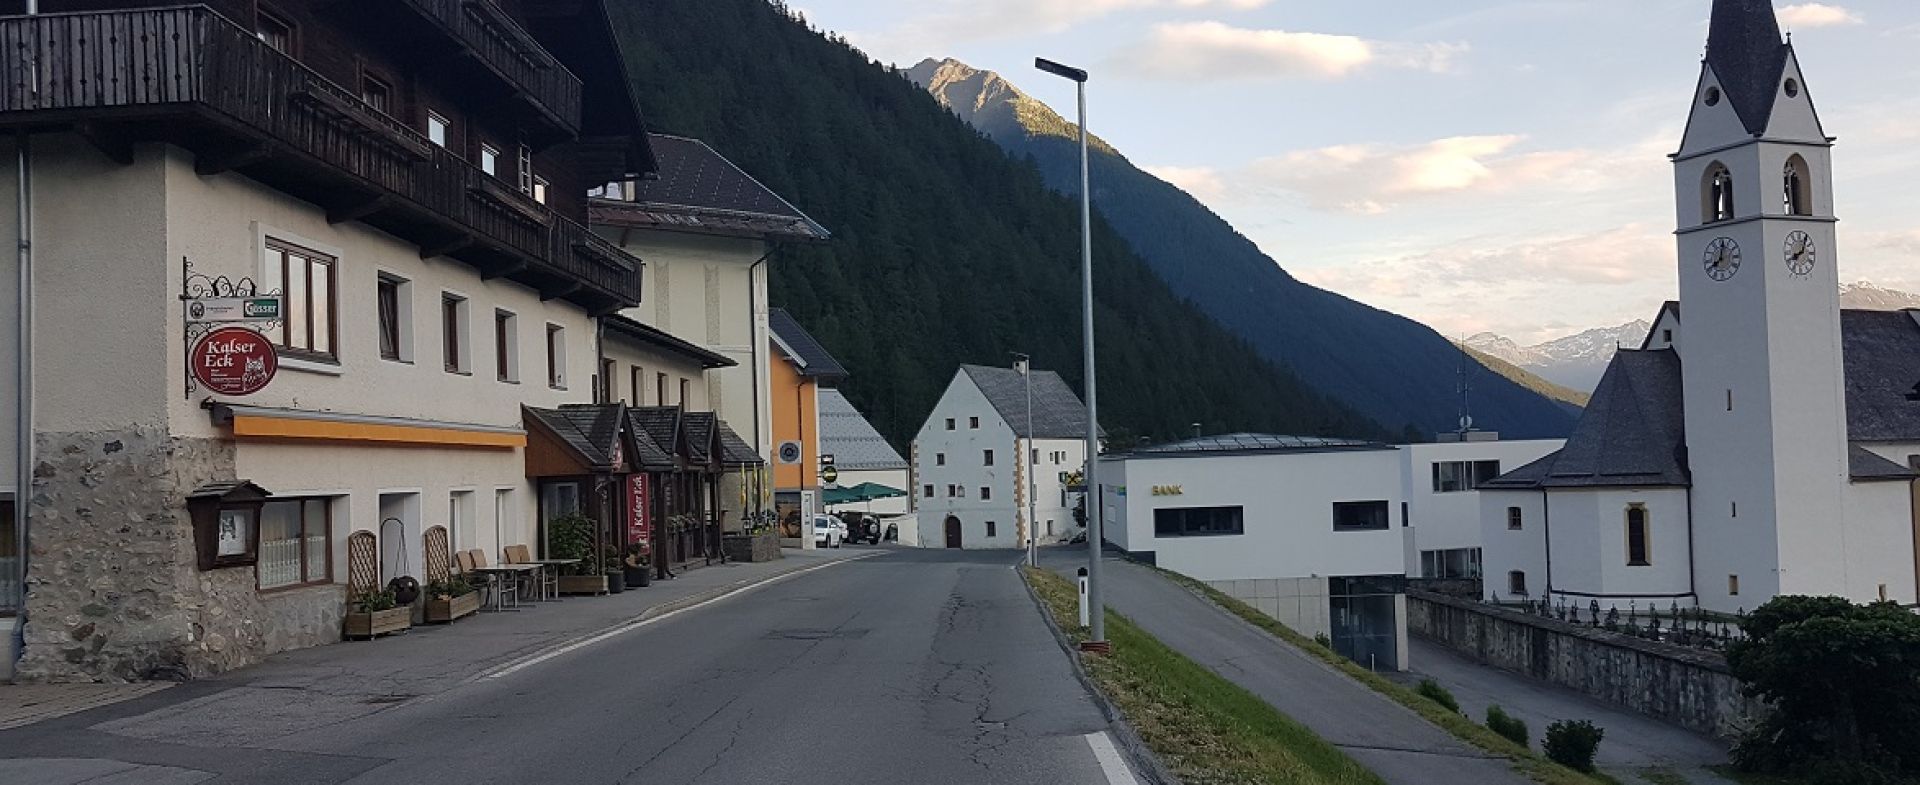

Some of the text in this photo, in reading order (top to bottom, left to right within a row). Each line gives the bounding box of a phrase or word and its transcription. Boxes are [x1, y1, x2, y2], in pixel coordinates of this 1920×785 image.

[207, 338, 256, 354] Kalser
[205, 354, 235, 367] Eck
[1152, 485, 1183, 496] BANK
